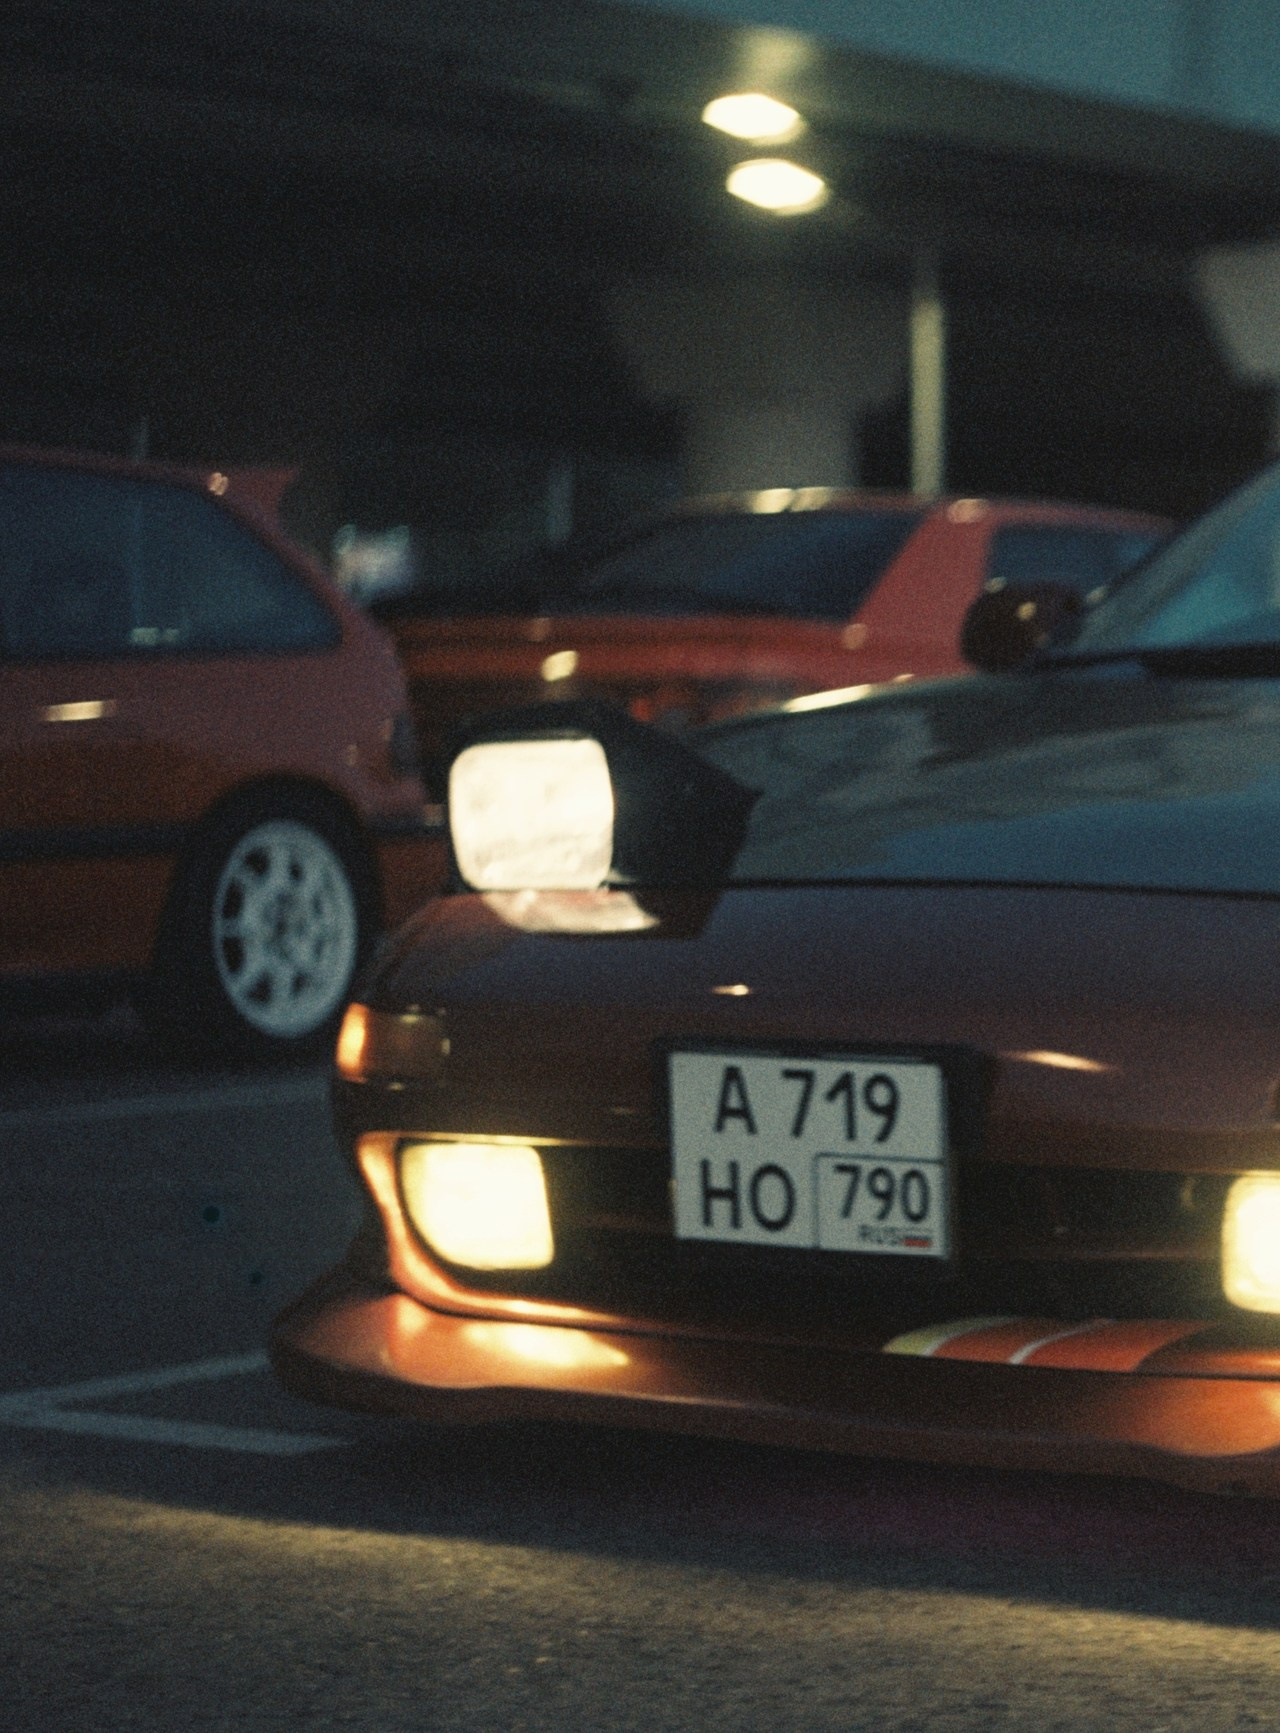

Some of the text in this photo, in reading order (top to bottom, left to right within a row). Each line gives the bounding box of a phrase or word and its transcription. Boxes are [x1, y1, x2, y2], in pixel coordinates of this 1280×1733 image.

[714, 1066, 899, 1143] A 719
[700, 1158, 795, 1233] HO
[833, 1164, 929, 1223] 790
